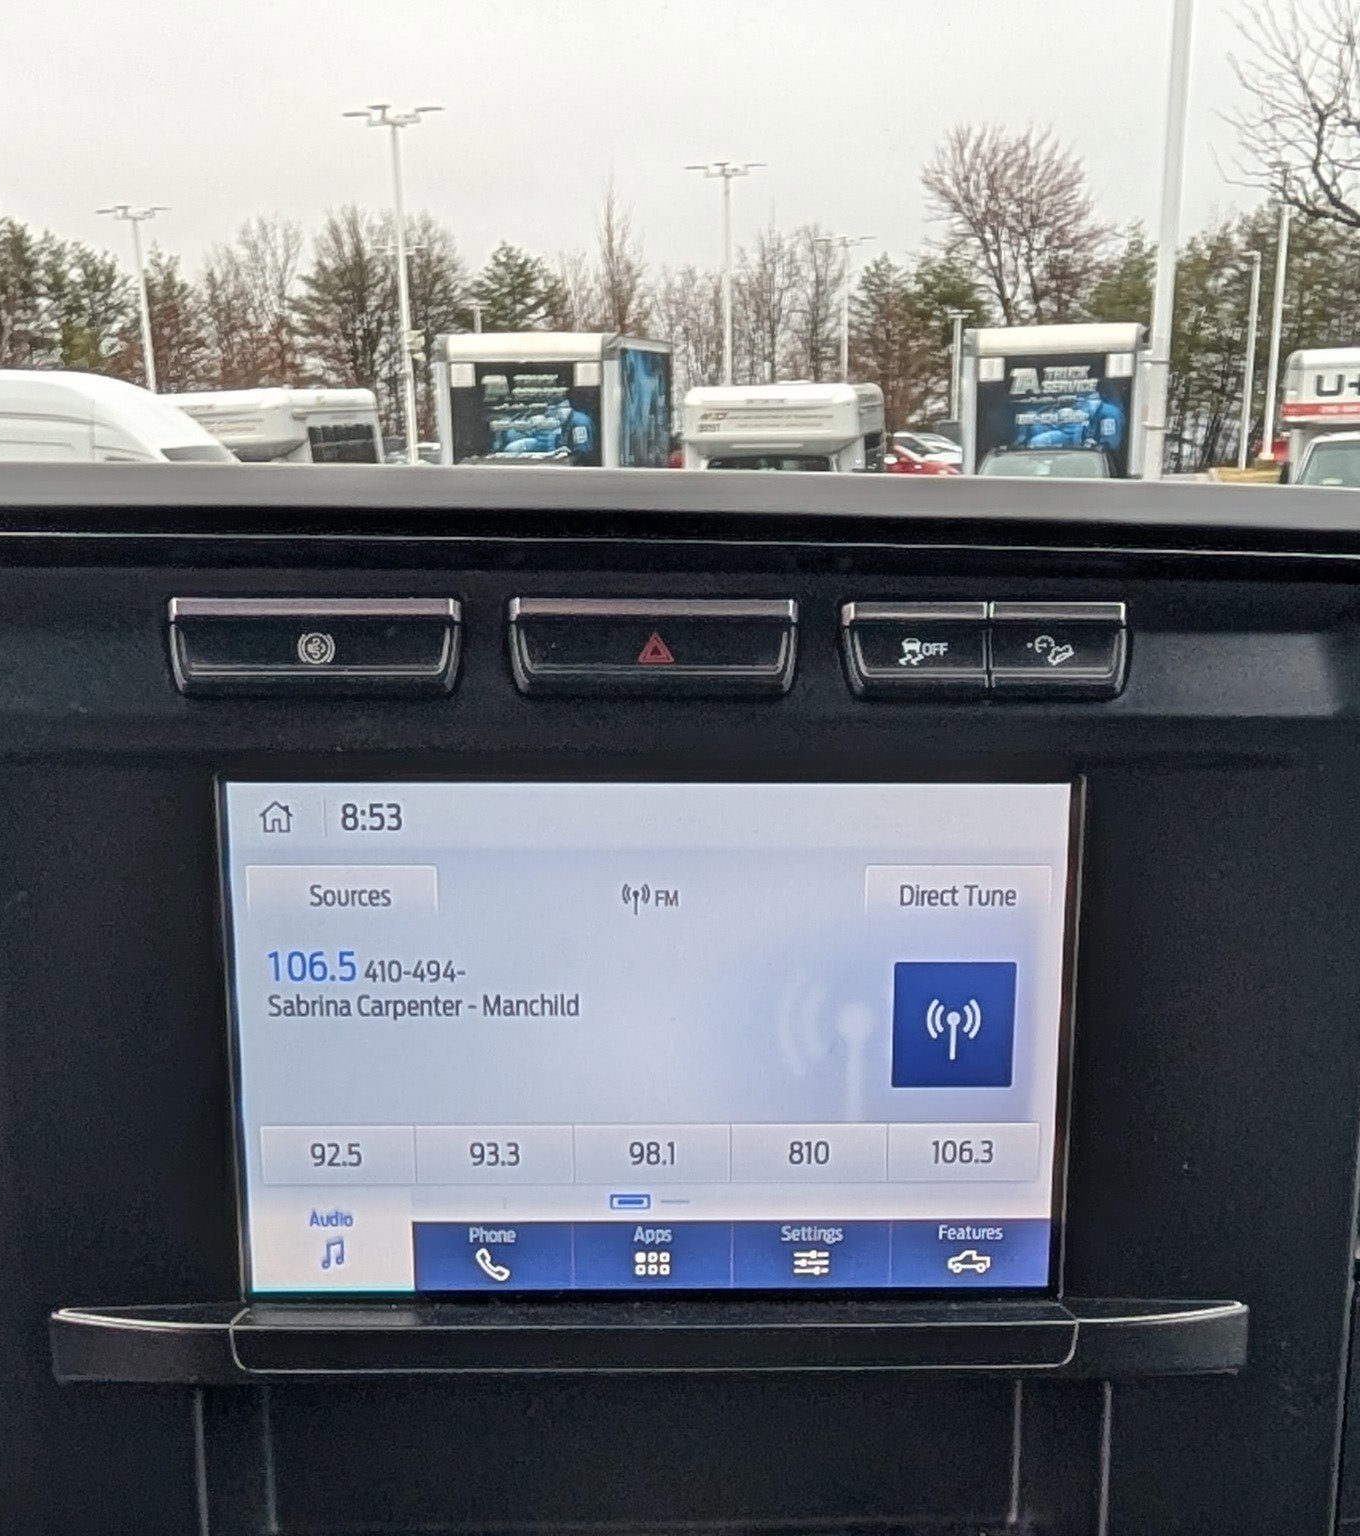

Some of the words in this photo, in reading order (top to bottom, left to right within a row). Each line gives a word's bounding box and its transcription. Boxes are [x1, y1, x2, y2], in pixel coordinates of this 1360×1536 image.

[922, 642, 948, 656] OFF
[340, 802, 403, 831] 8:53
[309, 884, 392, 907] Sources
[654, 890, 679, 907] FM
[899, 885, 959, 907] Direct
[964, 885, 1017, 907] Tune
[267, 950, 357, 982] 106.5
[364, 959, 466, 983] 410-494-
[268, 993, 352, 1017] Sabrina
[357, 993, 464, 1020] Carpenter
[483, 992, 580, 1017] Manchild
[310, 1142, 363, 1167] 92.5
[469, 1142, 521, 1167] 93.3
[628, 1141, 676, 1166] 98.1
[788, 1140, 830, 1165] 810
[931, 1140, 994, 1165] 106.3
[309, 1210, 354, 1228] Audio
[468, 1226, 516, 1244] Phone
[633, 1226, 672, 1244] Apps
[781, 1226, 844, 1244] Settings
[938, 1225, 1003, 1241] Features
